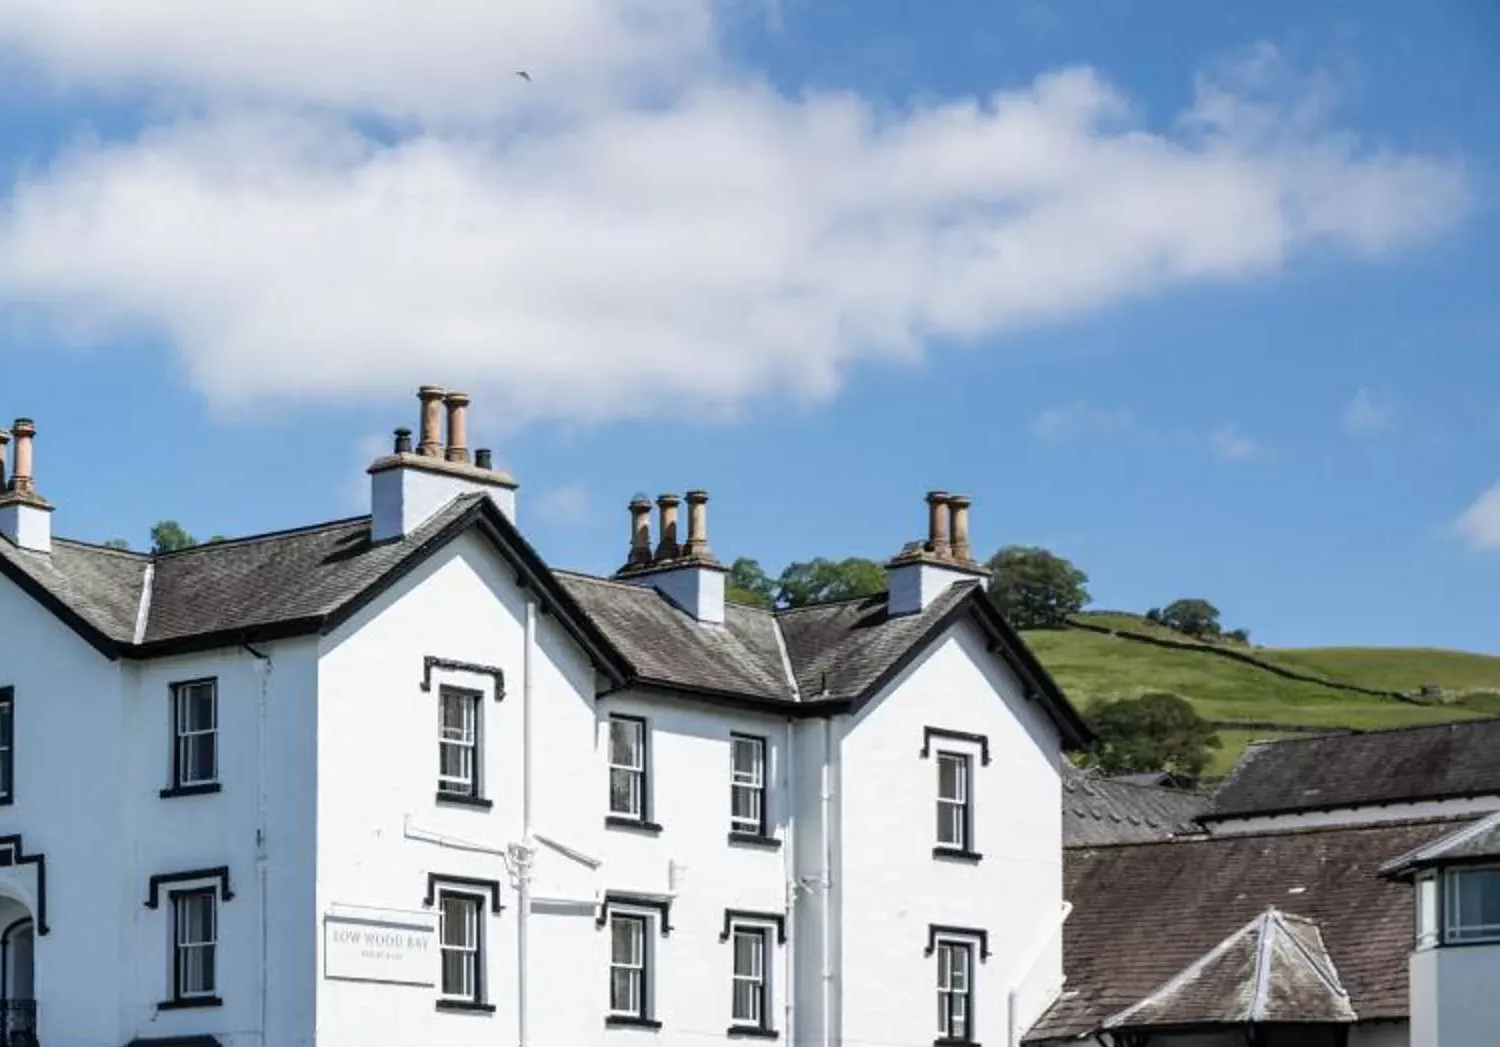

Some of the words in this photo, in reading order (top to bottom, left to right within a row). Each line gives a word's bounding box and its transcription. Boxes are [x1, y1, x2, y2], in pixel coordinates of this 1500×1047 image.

[333, 929, 361, 944] LOW
[364, 931, 403, 948] WOOD
[407, 935, 430, 952] BAY
